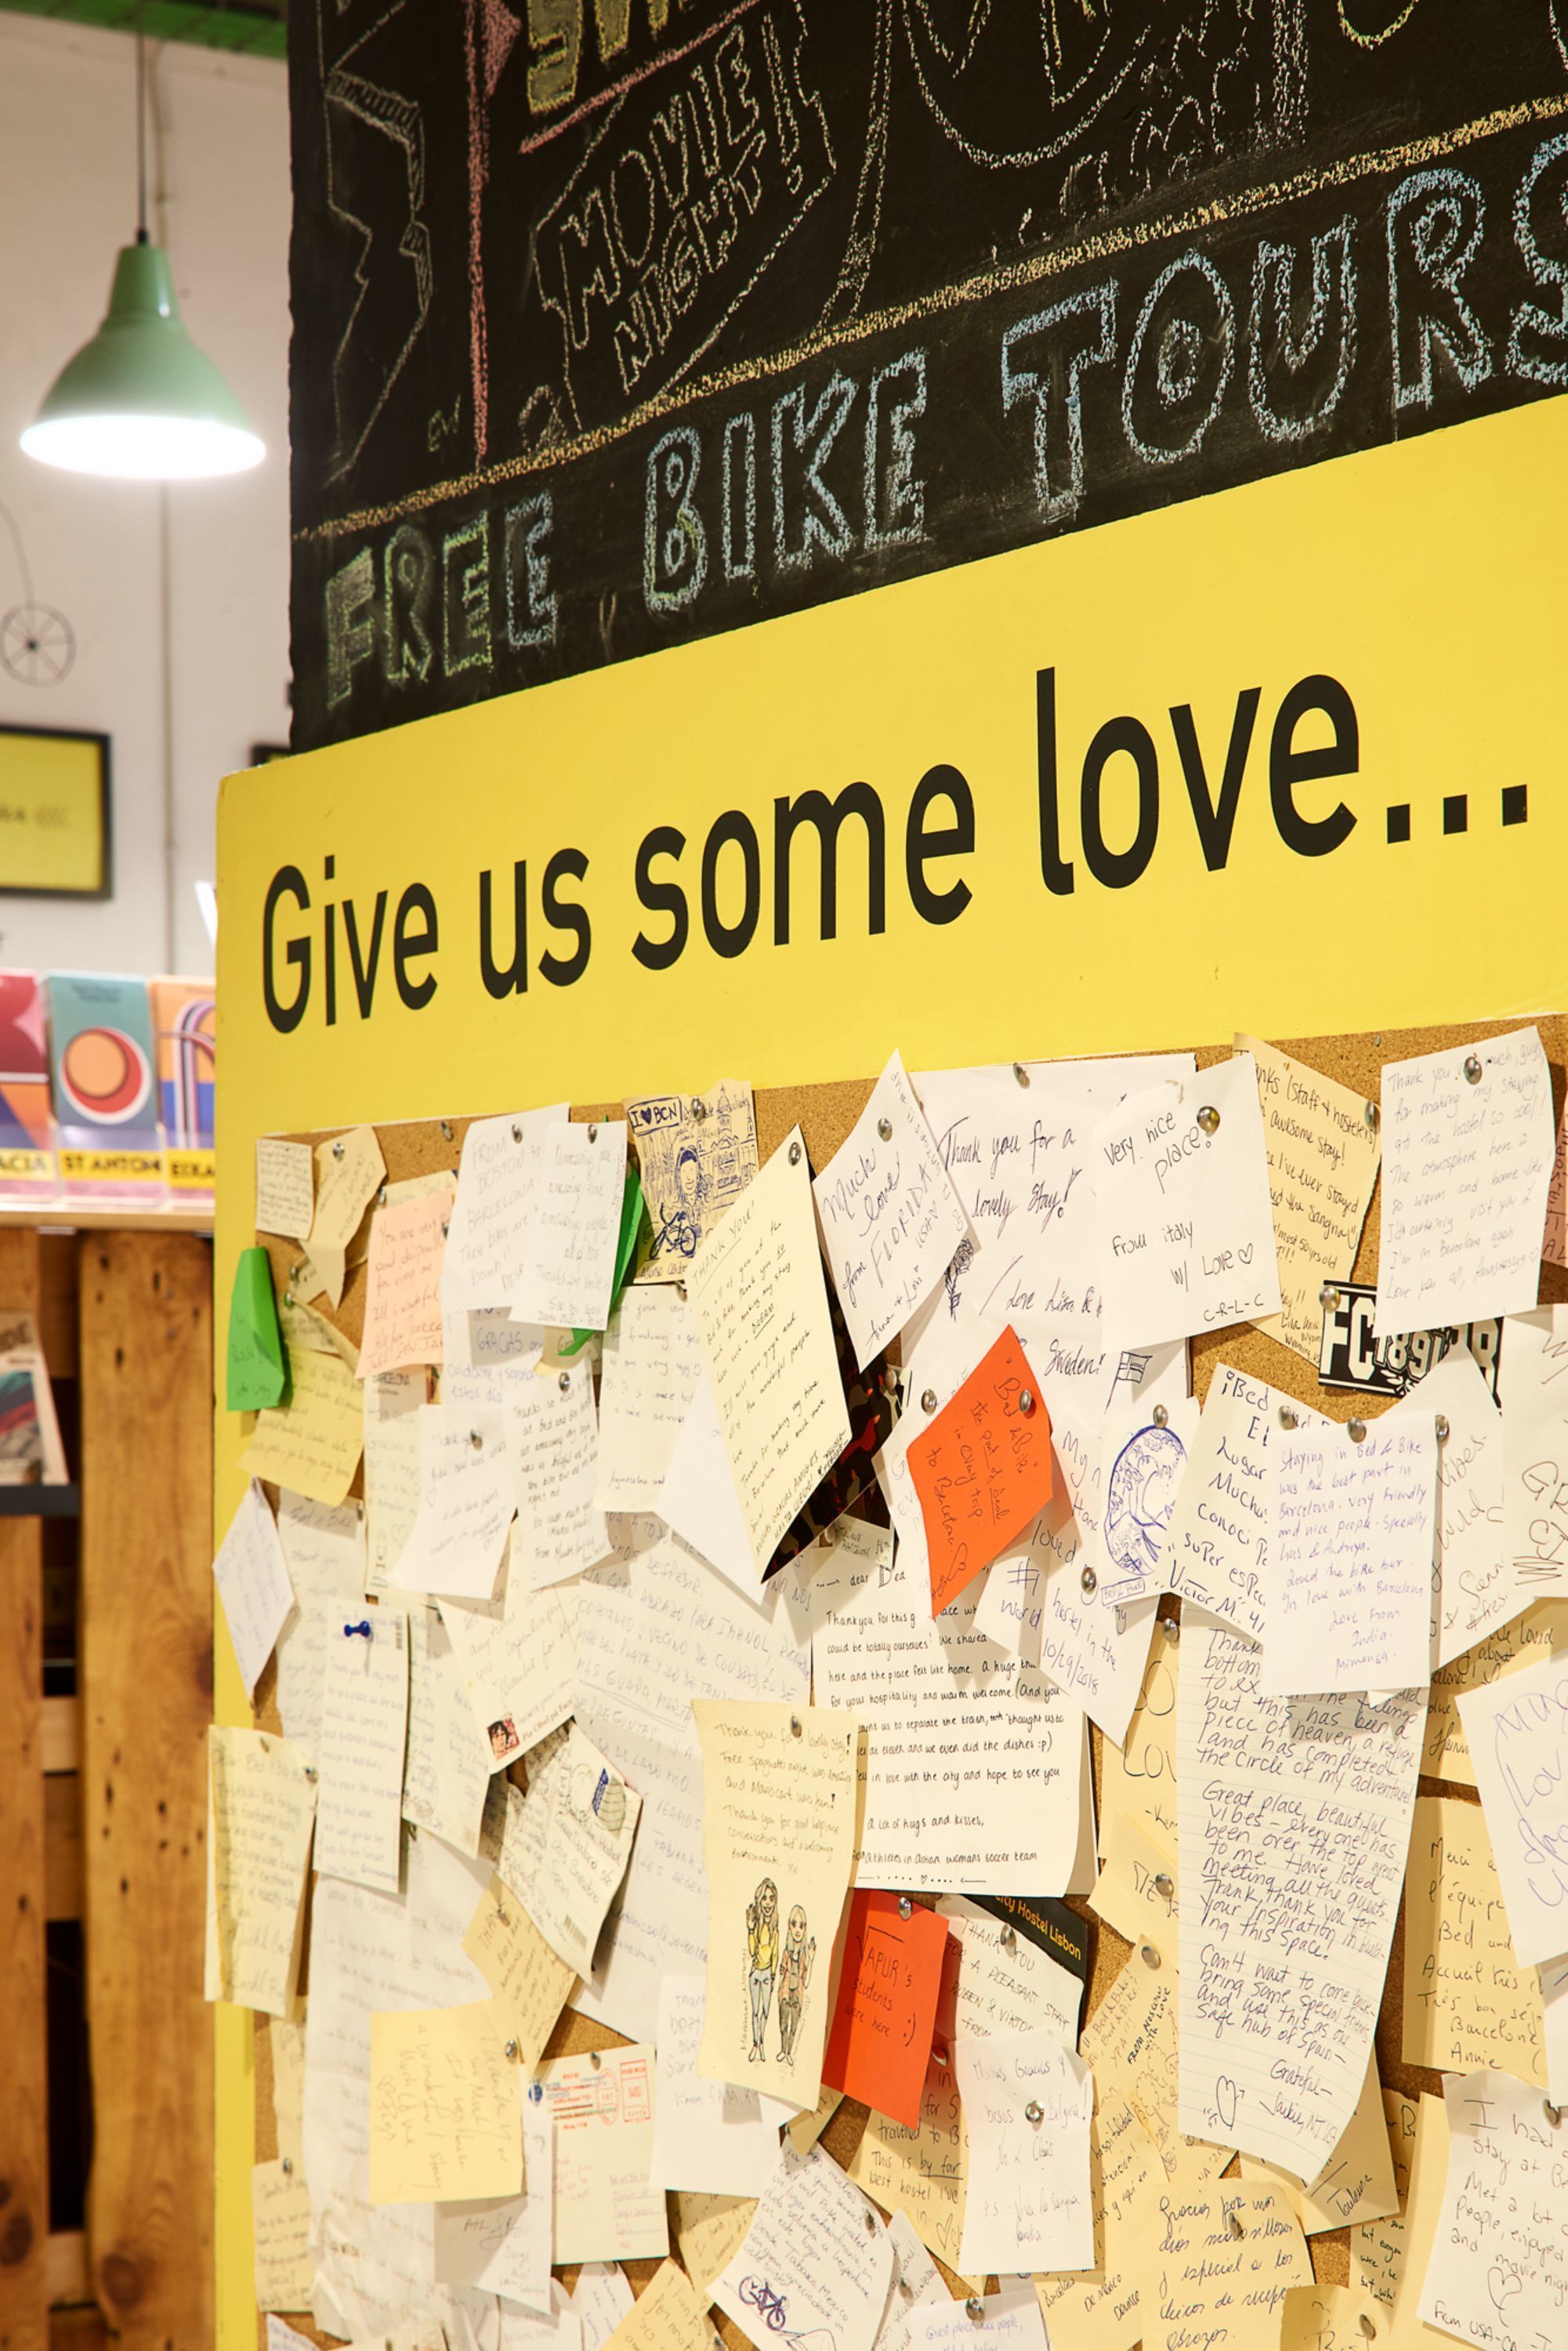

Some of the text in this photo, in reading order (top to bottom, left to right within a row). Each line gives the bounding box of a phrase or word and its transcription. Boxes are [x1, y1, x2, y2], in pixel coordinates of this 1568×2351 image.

[559, 24, 761, 351] MOVIE
[325, 132, 1568, 705] FREE BIKE TOURS
[261, 853, 439, 1036] Give
[476, 843, 592, 1001] us
[631, 762, 976, 972] some
[1388, 1071, 1424, 1093] Thank
[654, 1102, 677, 1125] BCN
[1146, 1112, 1176, 1144] nice
[937, 1116, 1077, 1179] Thank you for a
[823, 1146, 876, 1225] Much
[972, 1189, 1017, 1239] lovely
[842, 1163, 933, 1310] from FLORIDA
[1202, 1250, 1235, 1277] Love
[1357, 1439, 1377, 1458] Bed
[1398, 1436, 1422, 1454] Bike
[1331, 1462, 1394, 1488] best part
[1305, 1523, 1328, 1537] nice
[994, 1660, 1016, 1680] huge
[906, 1720, 939, 1733] separate
[1004, 1737, 1034, 1751] dishes
[987, 1770, 1007, 1785] hope
[1203, 1779, 1255, 1807] Great
[1317, 1800, 1389, 1838] beautiful
[903, 1818, 927, 1837] hugs
[1014, 1851, 1037, 1861] team
[1262, 1835, 1367, 1871] over top
[1284, 1853, 1380, 1896] Have loved
[1018, 1900, 1048, 1935] Hostel
[1049, 1925, 1081, 1961] Lisbon
[1438, 1918, 1474, 1950] Bed
[853, 1977, 893, 2011] students
[987, 1966, 1040, 2004] PLEASANT
[1156, 1987, 1171, 2020] LOVE
[845, 2007, 889, 2038] were here
[1126, 1985, 1162, 2066] FROM MOSCOW
[1241, 2015, 1271, 2038] hub
[1450, 2041, 1504, 2070] Annie
[1512, 2113, 1554, 2149] had
[871, 2151, 893, 2168] This
[919, 2150, 933, 2179] by
[1473, 2137, 1541, 2186] stay at
[869, 2171, 891, 2188] best
[900, 2178, 931, 2201] hostel
[1465, 2170, 1498, 2201] Met
[1495, 2253, 1537, 2280] movie
